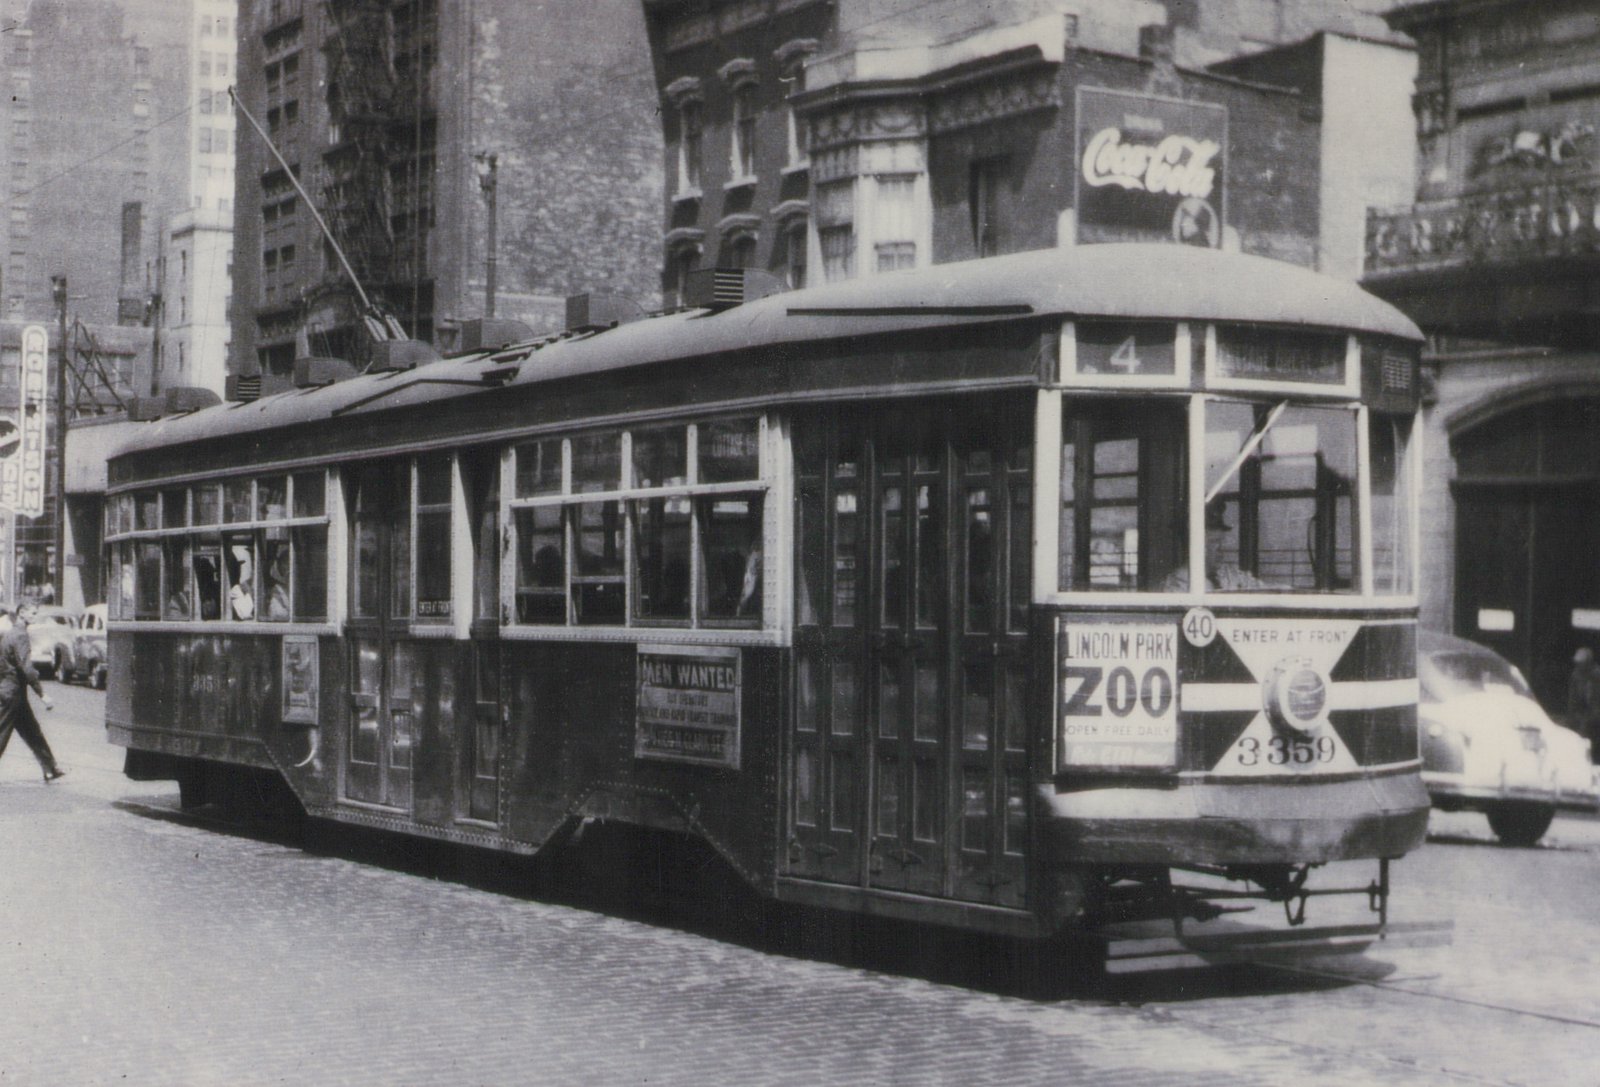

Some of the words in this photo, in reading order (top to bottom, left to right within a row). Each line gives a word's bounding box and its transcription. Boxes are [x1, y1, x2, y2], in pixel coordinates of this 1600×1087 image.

[1109, 334, 1141, 374] 4
[1186, 614, 1212, 639] 40
[1232, 629, 1278, 643] ENTER
[1286, 630, 1303, 643] AT
[1309, 629, 1348, 643] FRONT
[1064, 631, 1130, 660] LINCOLN
[1135, 632, 1174, 660] PARK
[641, 661, 672, 686] MEN
[677, 664, 736, 690] WANTED
[1064, 666, 1173, 718] ZOO
[1066, 724, 1099, 737] OPEN
[1104, 725, 1132, 737] FREE
[1138, 724, 1170, 737] DAILY
[1237, 736, 1336, 766] 3359
